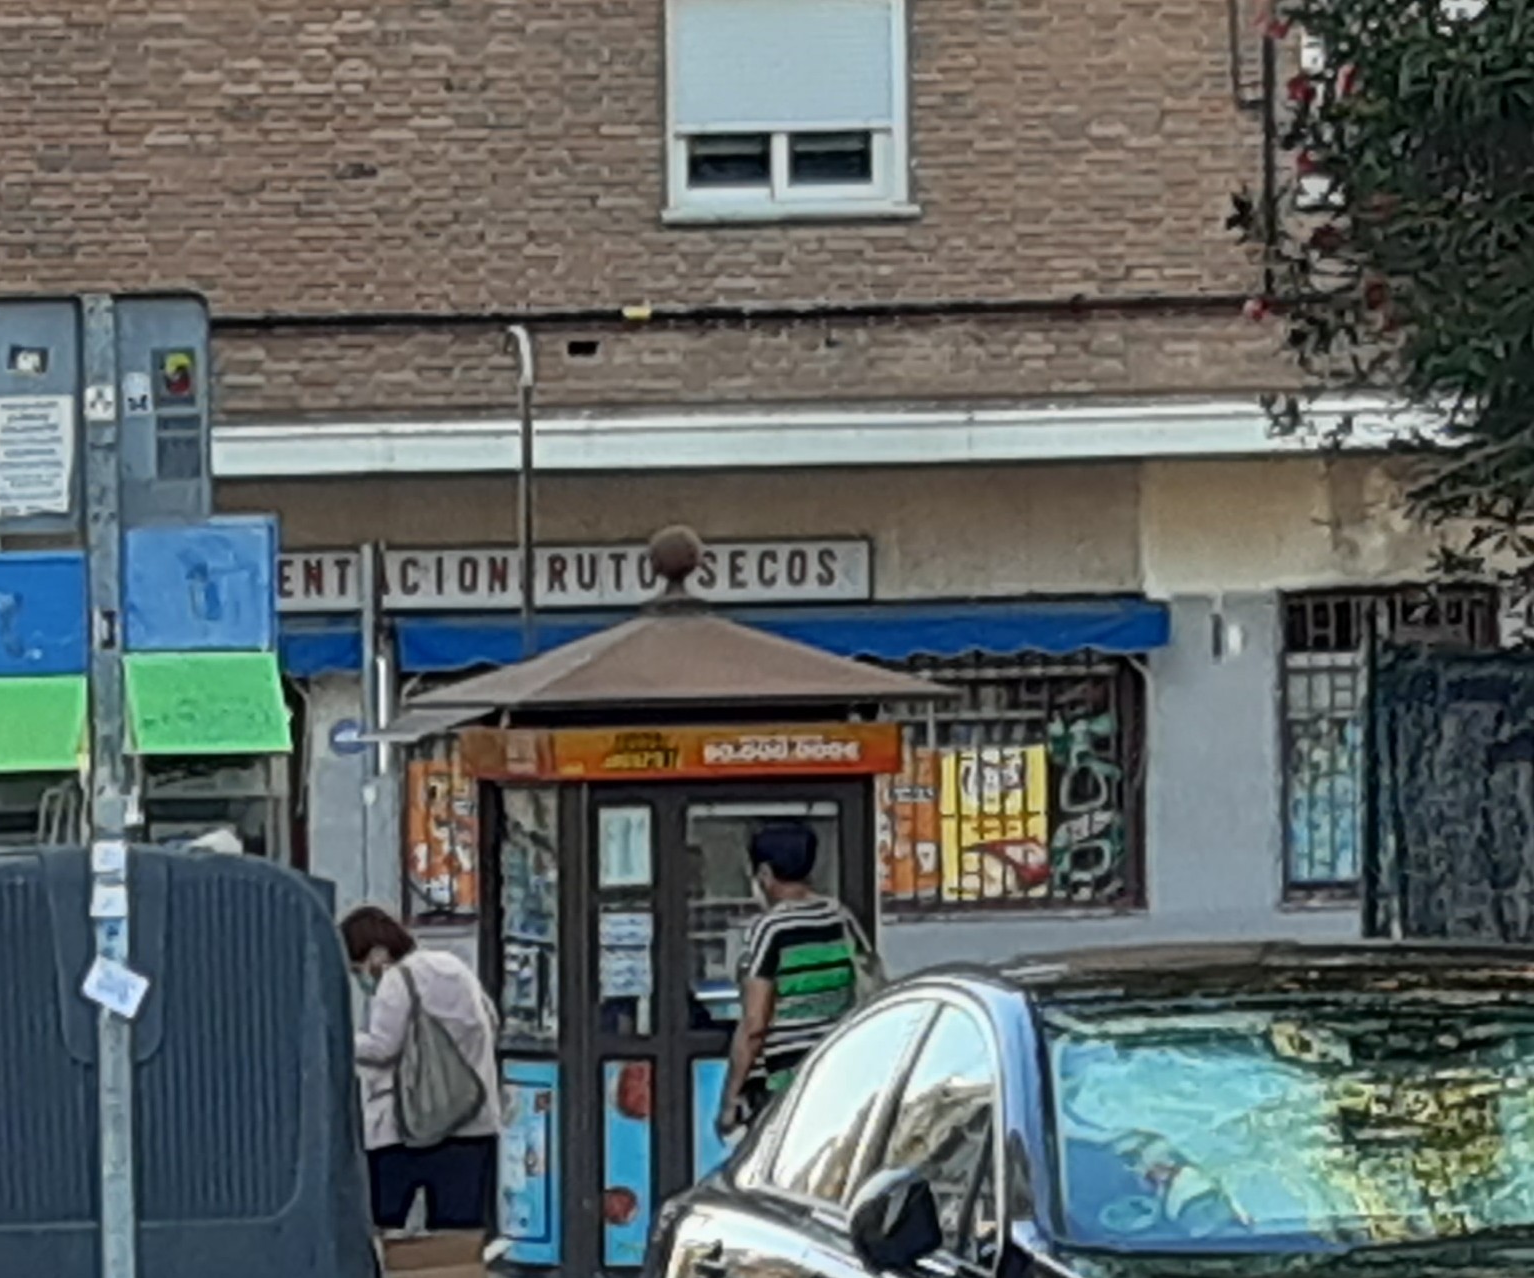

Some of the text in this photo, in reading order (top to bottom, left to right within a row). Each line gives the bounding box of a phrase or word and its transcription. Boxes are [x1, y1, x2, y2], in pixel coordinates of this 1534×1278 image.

[277, 548, 838, 598] ENTCION RUTO SECOS
